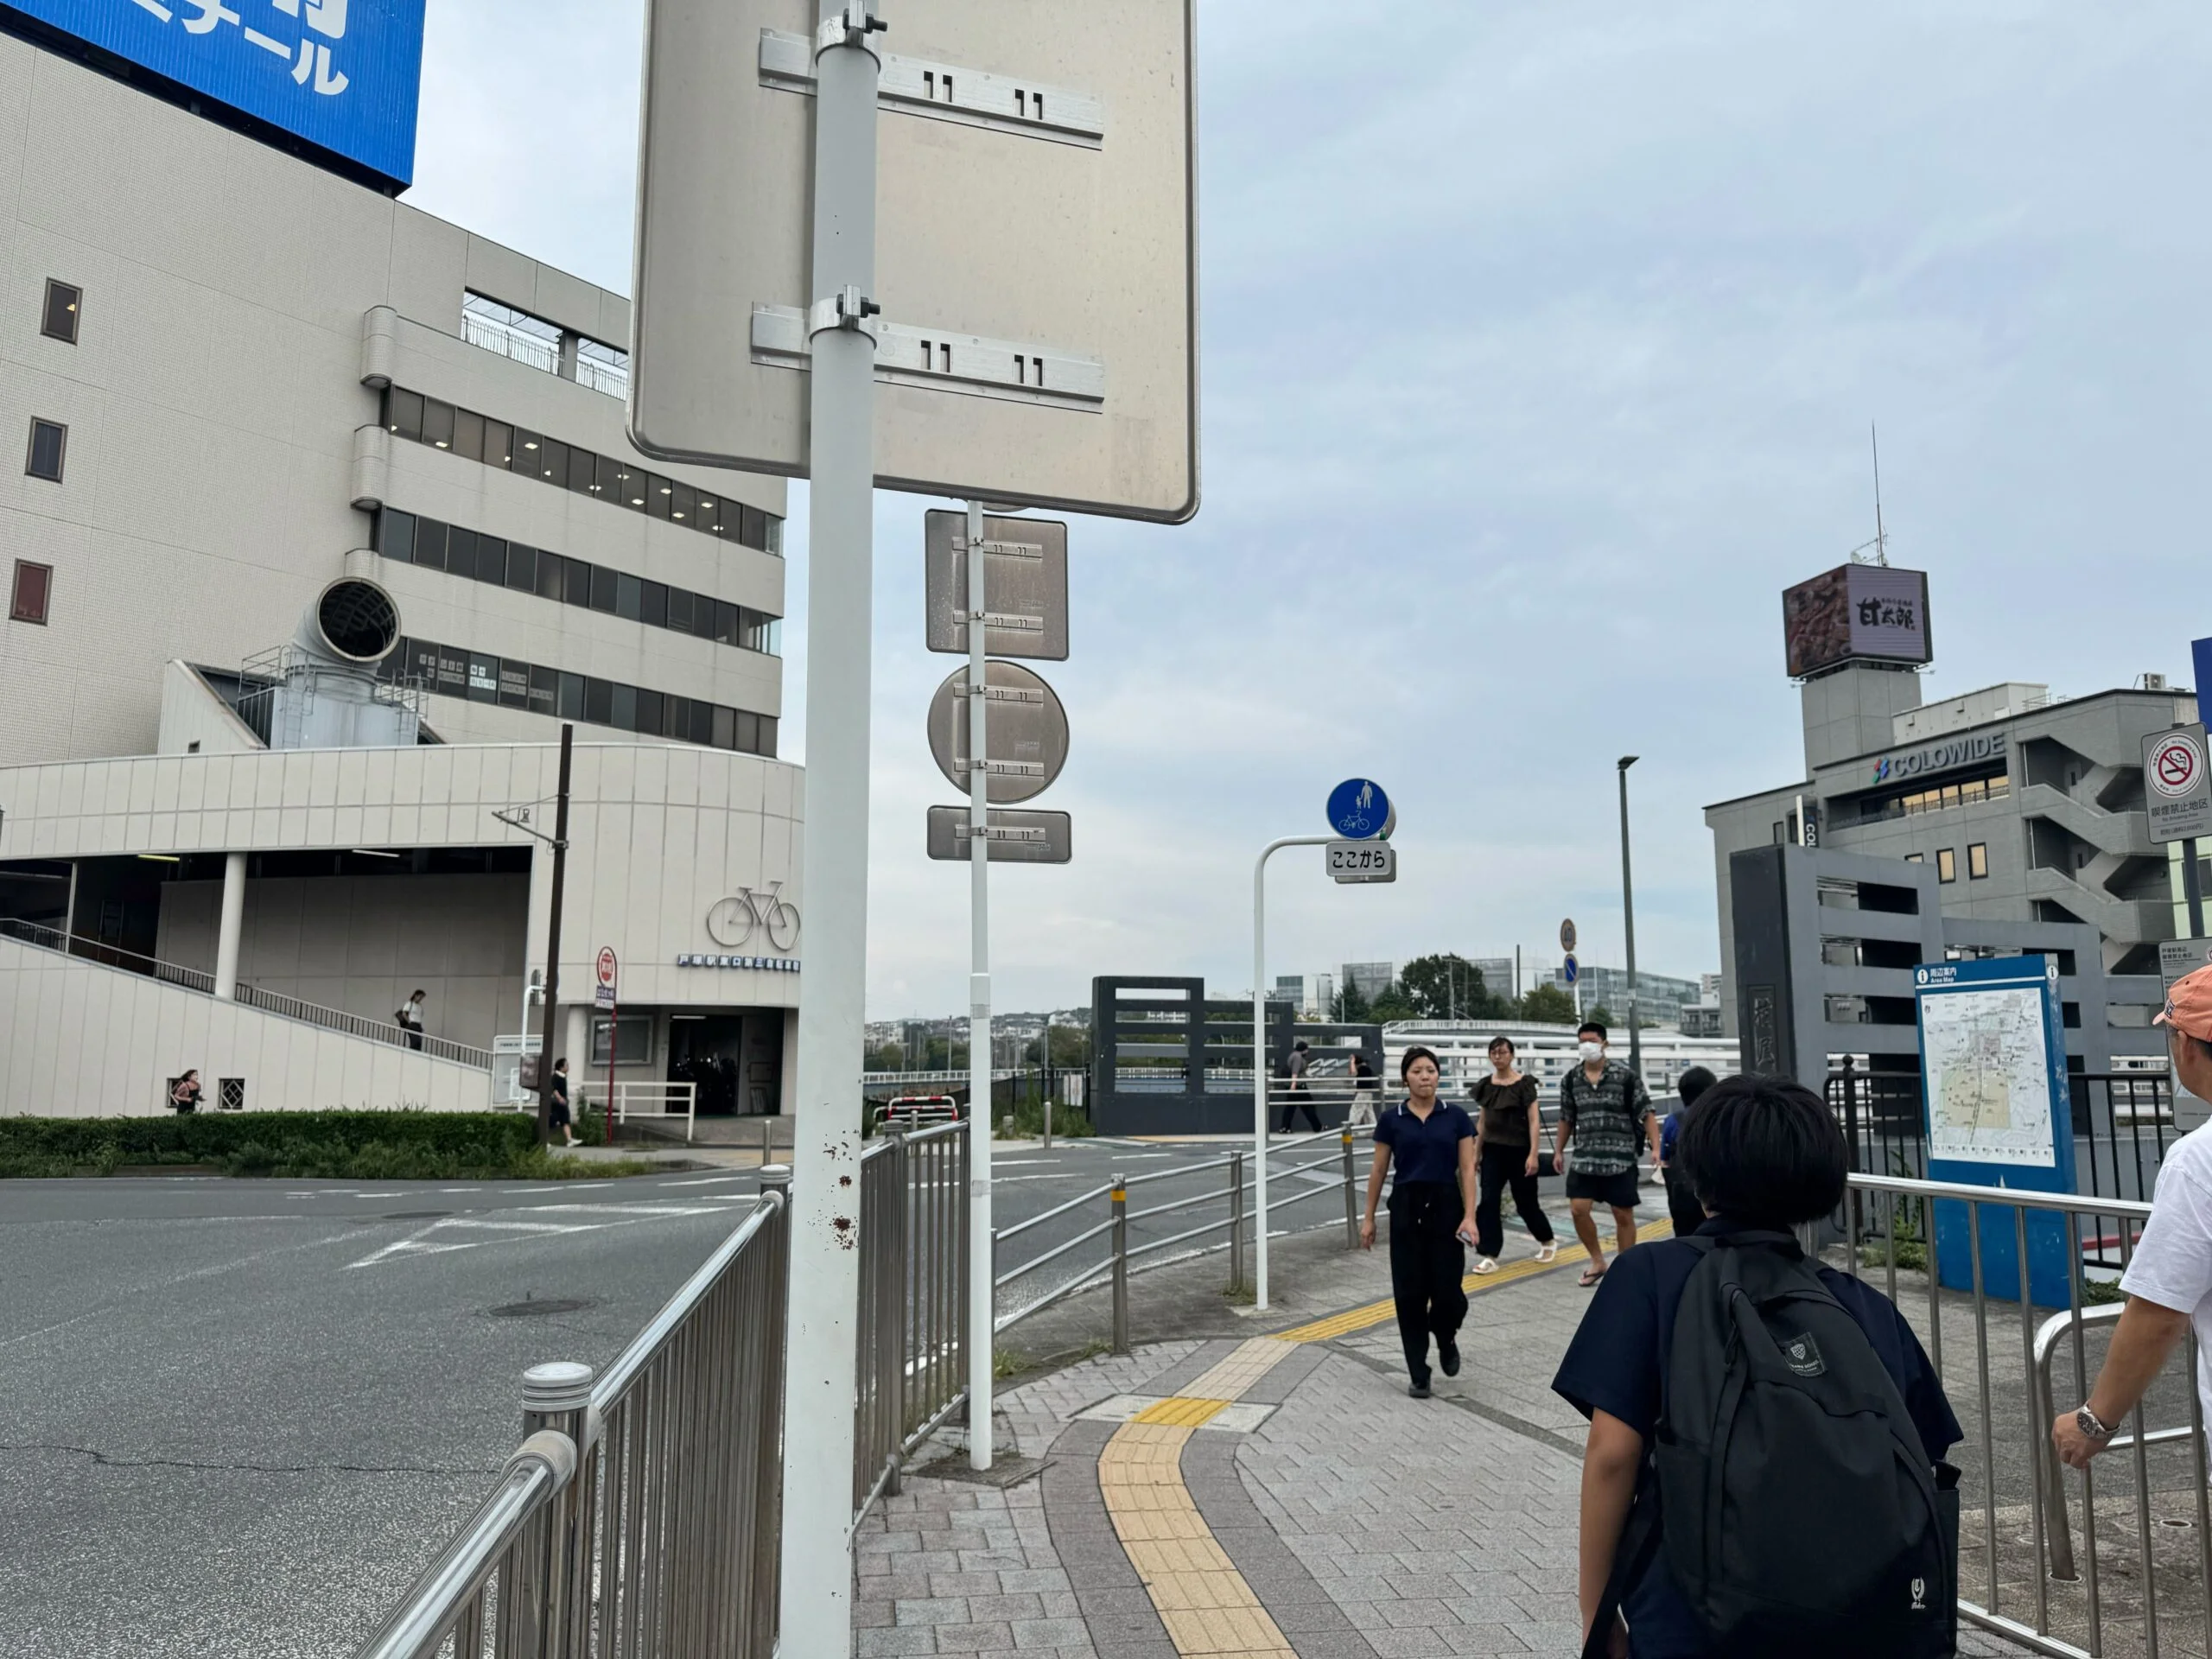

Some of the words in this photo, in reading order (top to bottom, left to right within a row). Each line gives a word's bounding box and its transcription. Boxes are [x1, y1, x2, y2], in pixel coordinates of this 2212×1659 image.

[1856, 597, 1915, 629] 甘太郎
[1893, 733, 2006, 777] COLOWIDE
[2152, 798, 2209, 817] 喫煙禁止地区
[1332, 849, 1385, 868] ここから
